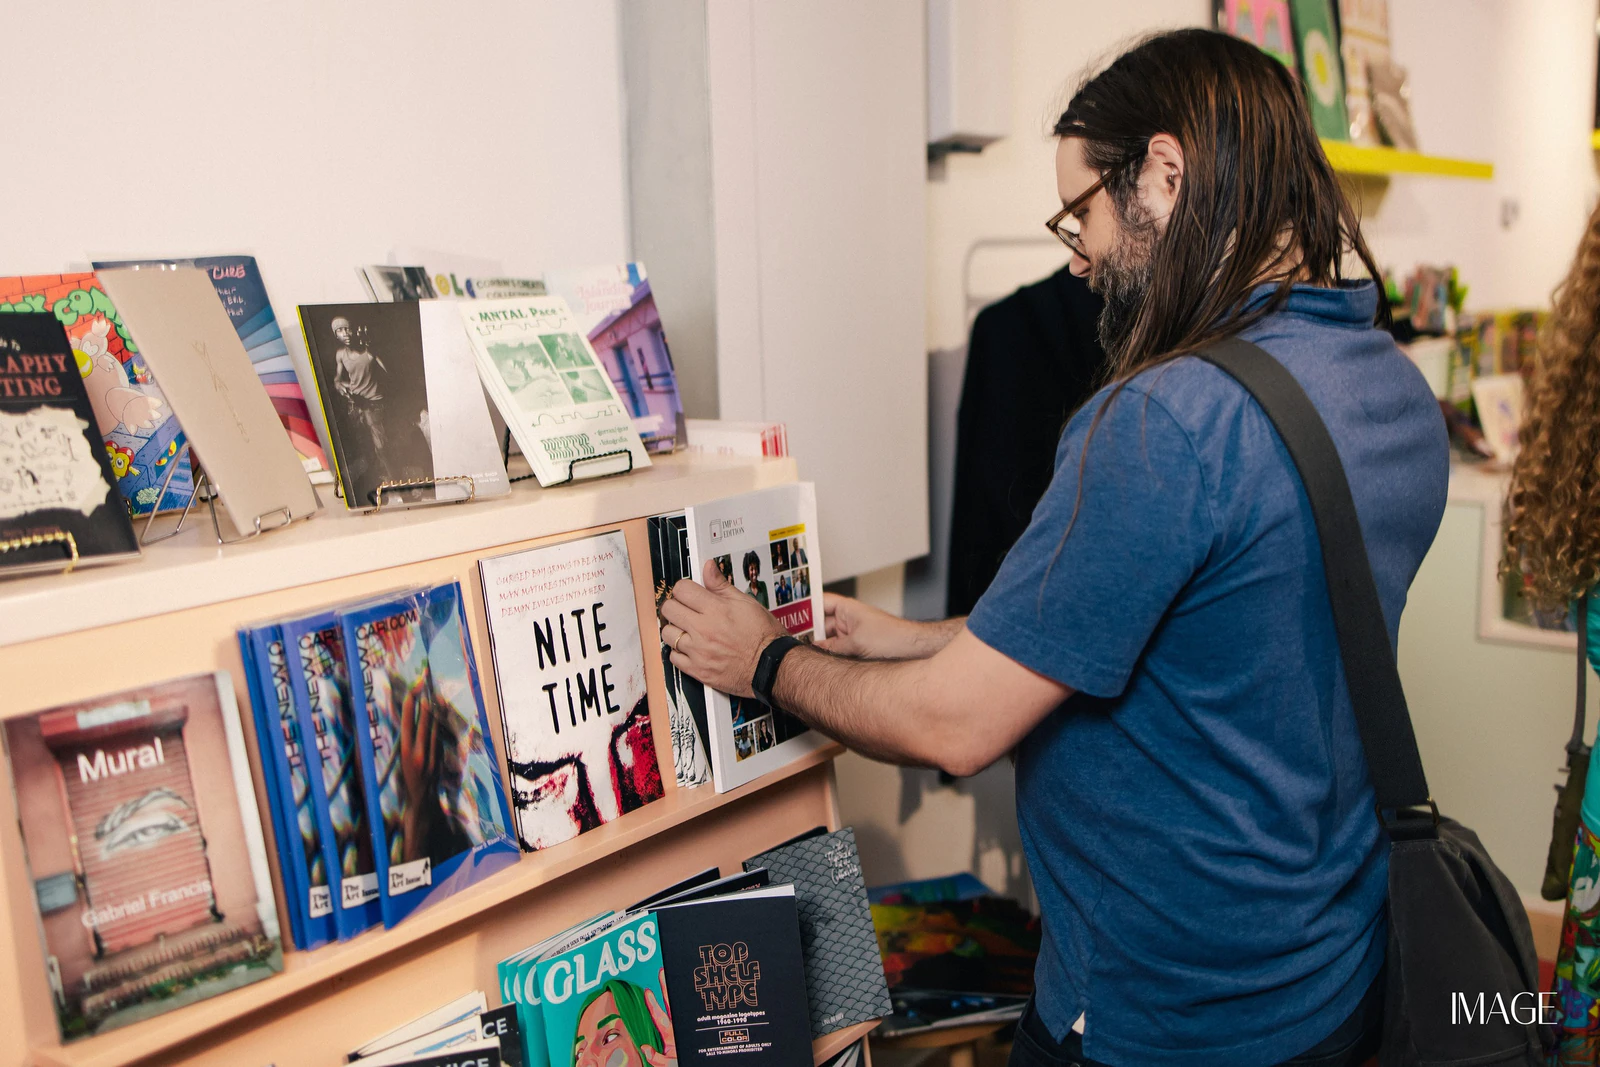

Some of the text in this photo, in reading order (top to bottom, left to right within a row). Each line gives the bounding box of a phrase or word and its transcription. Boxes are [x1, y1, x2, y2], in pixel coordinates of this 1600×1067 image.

[0, 354, 67, 373] APHY
[722, 517, 743, 529] IMPACT
[723, 527, 745, 539] EDITION
[598, 551, 614, 562] MAN
[499, 590, 519, 601] MAN
[521, 580, 558, 596] MATURES
[582, 568, 605, 581] DEMON
[501, 603, 530, 618] DEMON
[532, 595, 565, 610] EVOLVES
[533, 602, 611, 670] NITE
[542, 663, 620, 734] TIME
[77, 736, 165, 784] Mural
[390, 872, 404, 881] The
[391, 879, 404, 889] Art
[344, 884, 359, 893] The
[345, 892, 360, 901] Art
[81, 896, 146, 928] Gabriel
[543, 920, 657, 1004] GLASS
[699, 941, 749, 967] TOP
[694, 961, 760, 992] SHELF
[701, 982, 758, 1011] TYPE
[712, 1013, 738, 1021] magazine
